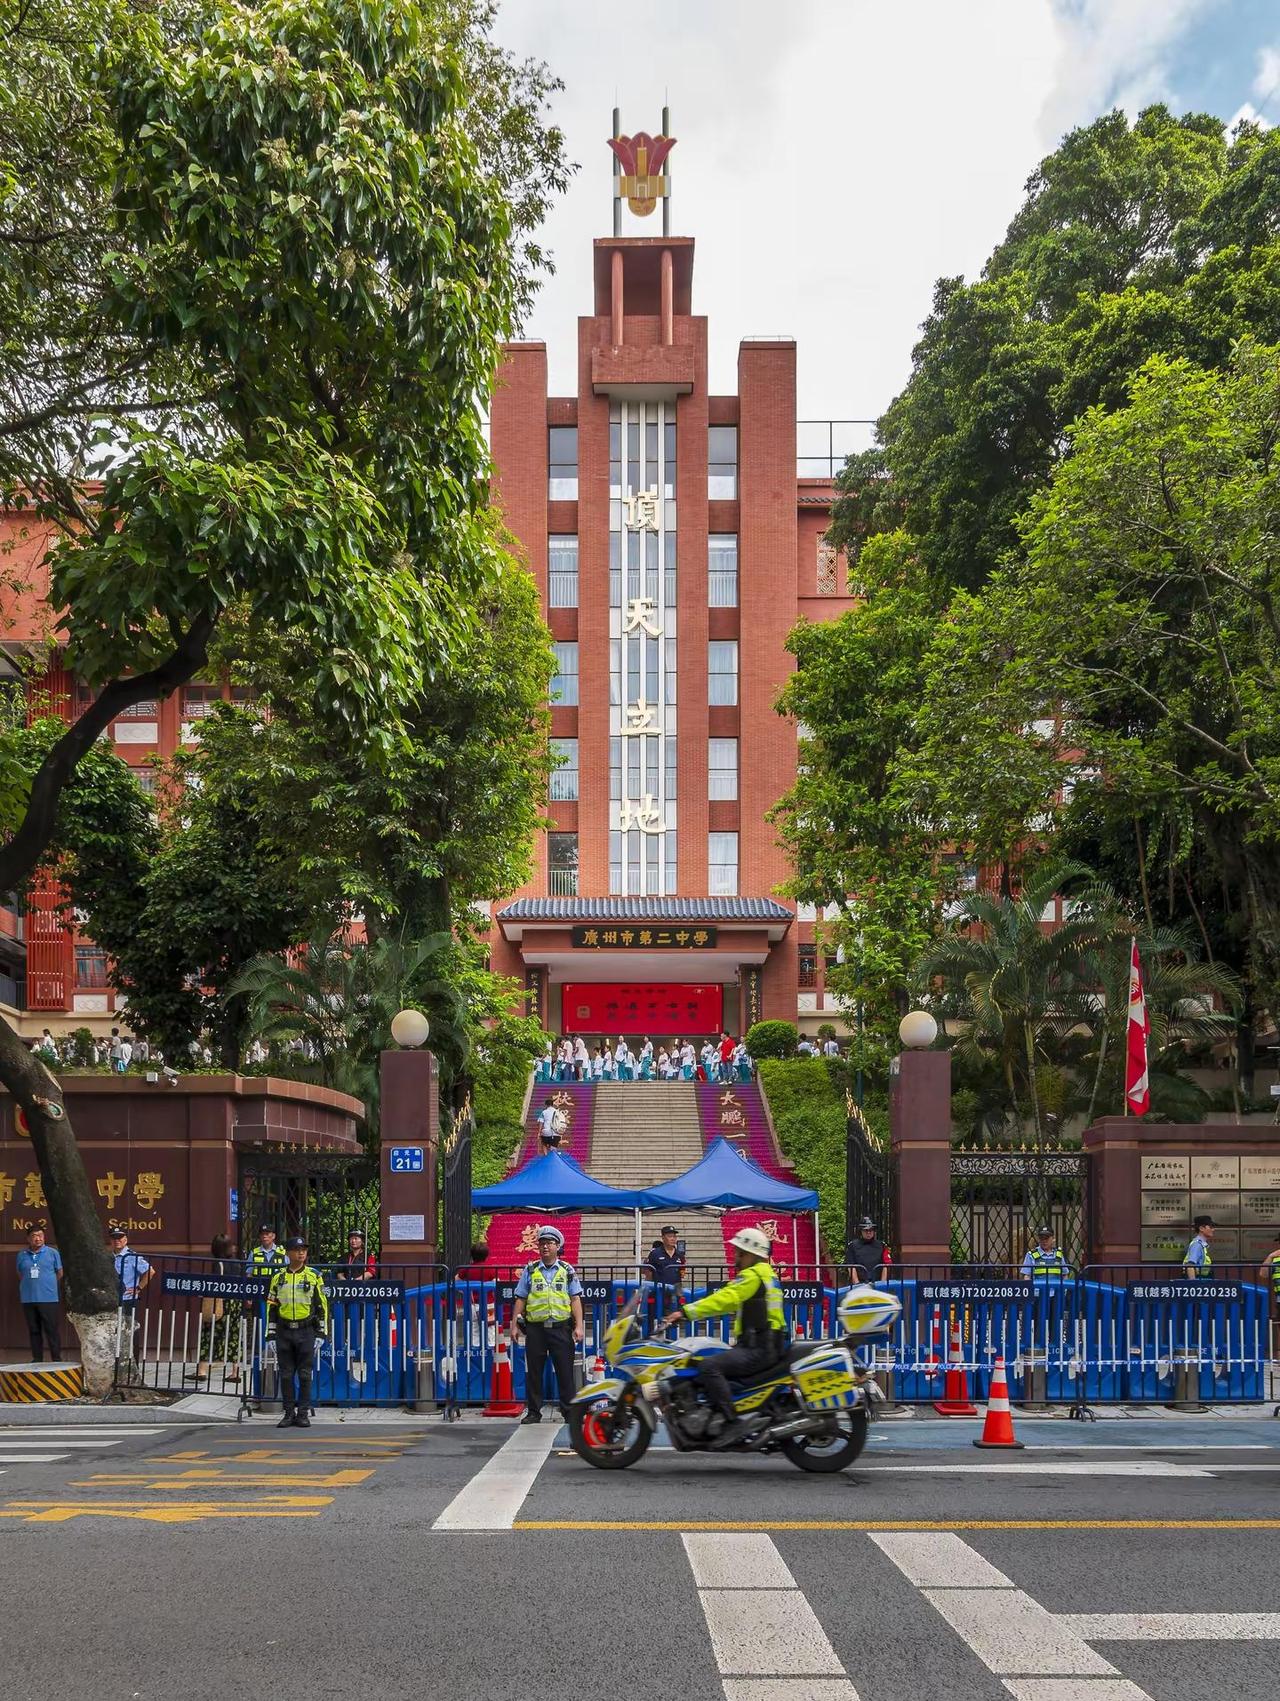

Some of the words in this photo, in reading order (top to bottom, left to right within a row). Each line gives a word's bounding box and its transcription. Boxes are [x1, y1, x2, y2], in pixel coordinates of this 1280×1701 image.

[620, 491, 666, 835] 頂天立地
[582, 929, 709, 946] 廣州市第二中學
[108, 1217, 162, 1230] School
[923, 1287, 1029, 1298] 穗(越秀)T20220820
[1133, 1286, 1238, 1298] 穗(越秀)T20220238
